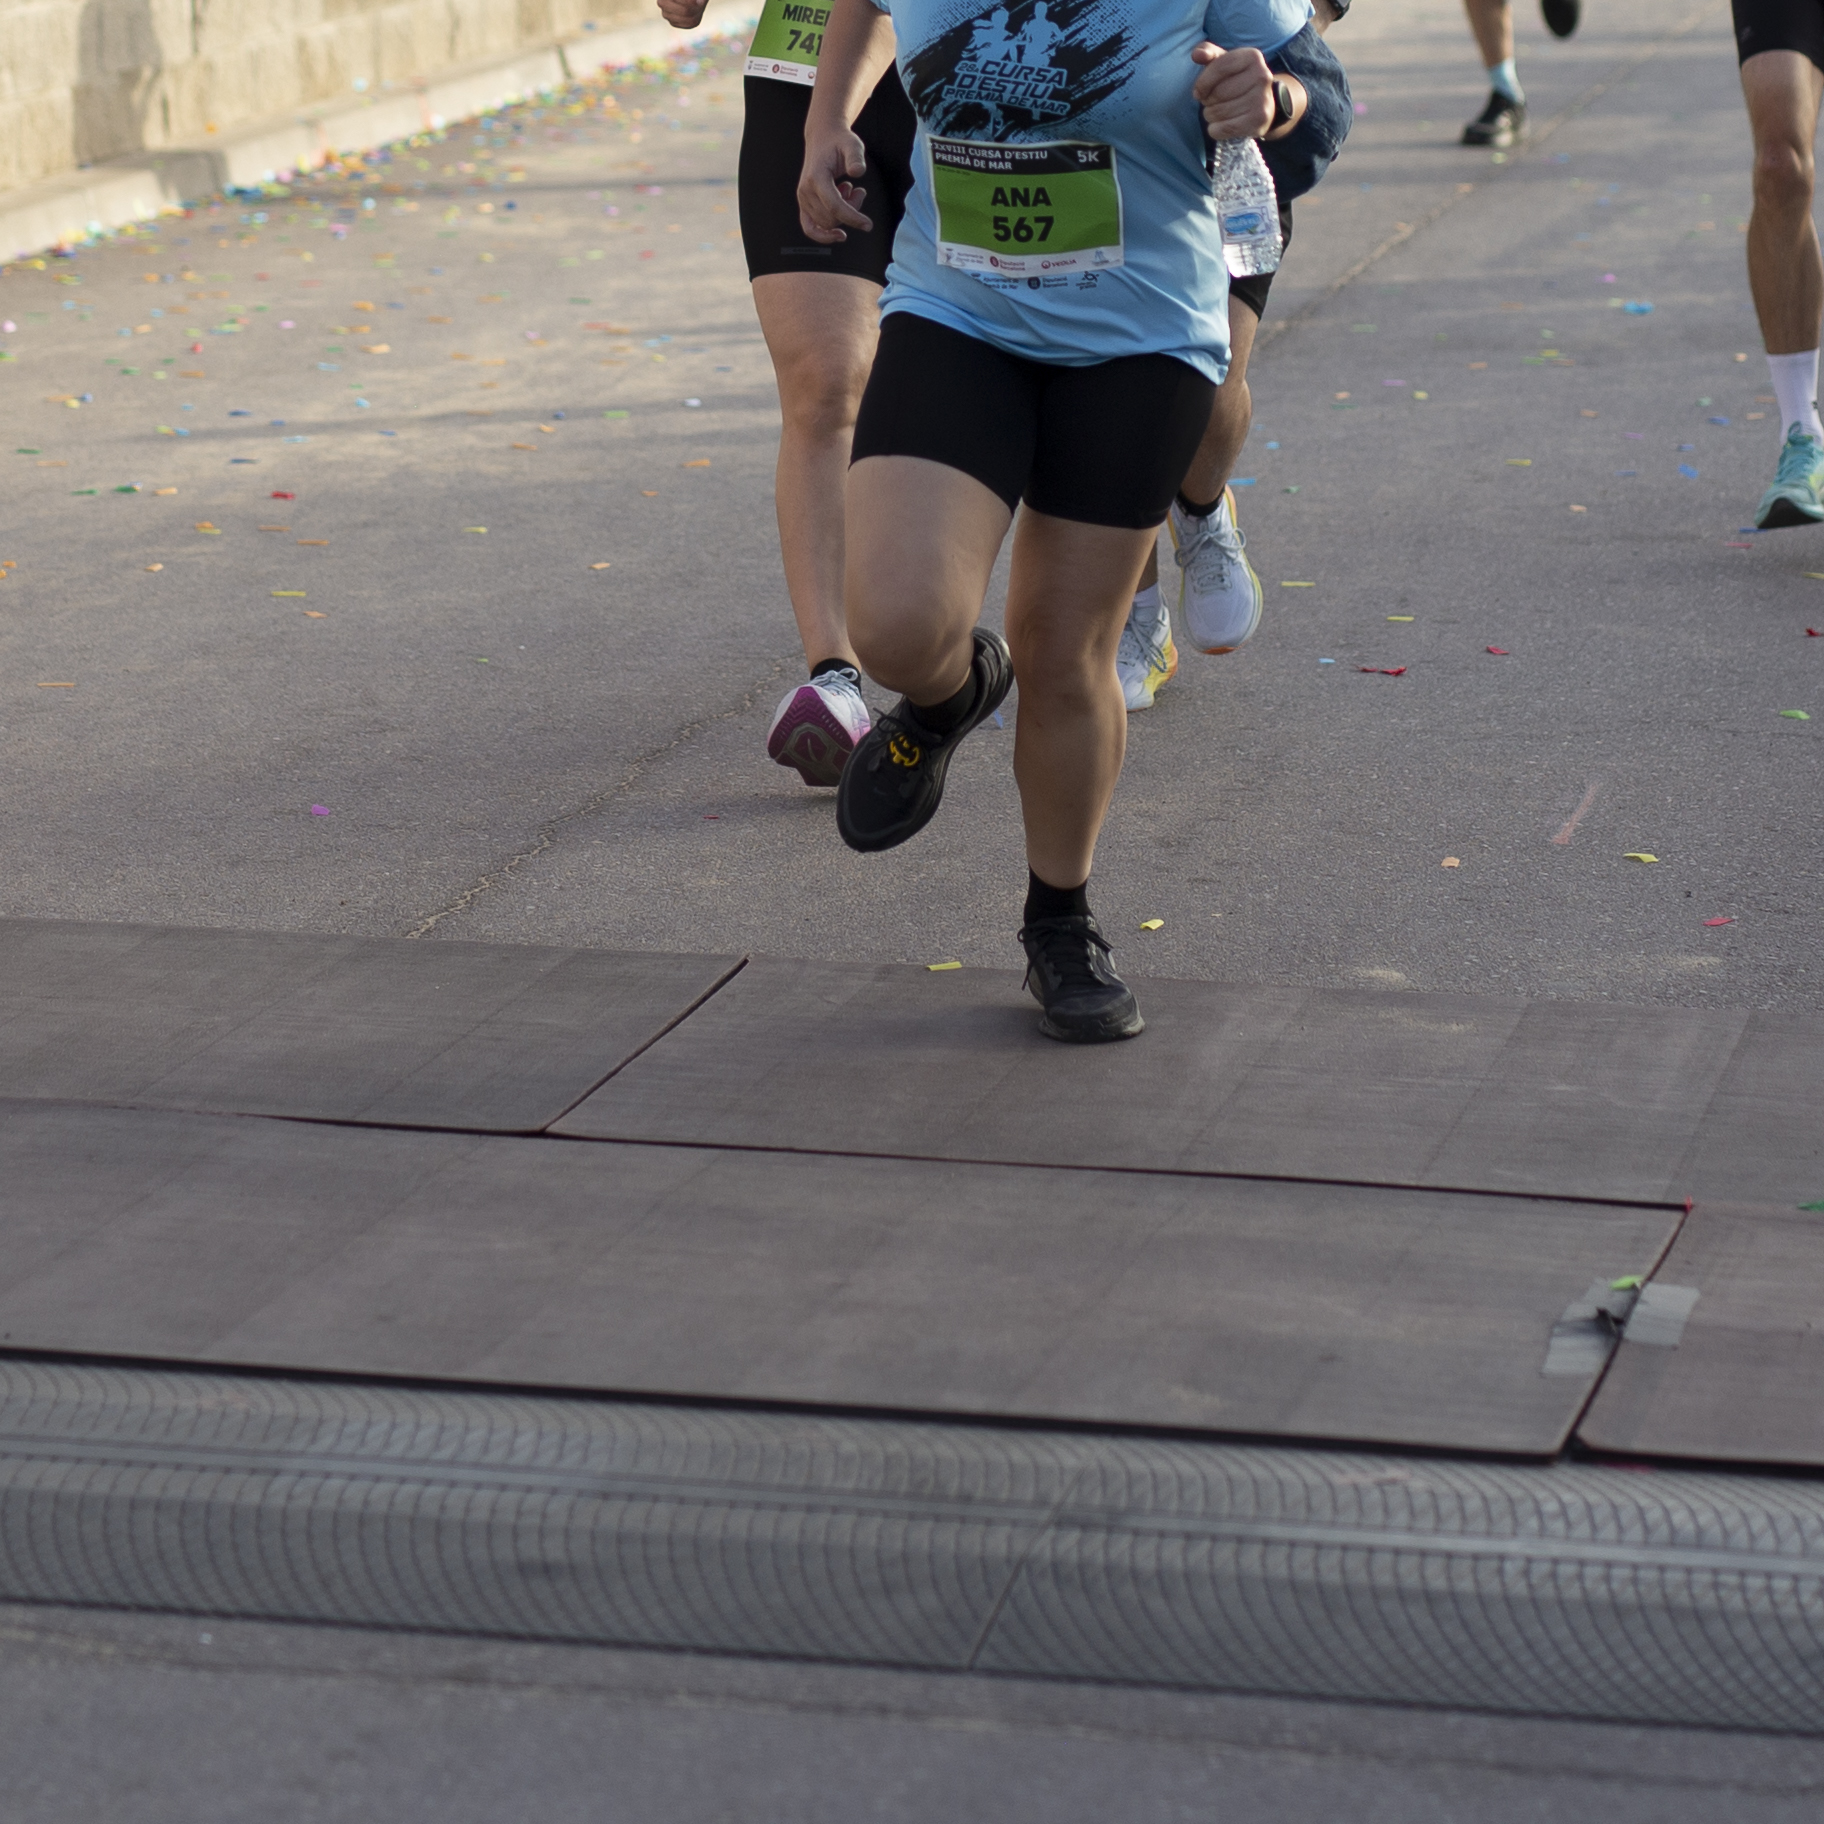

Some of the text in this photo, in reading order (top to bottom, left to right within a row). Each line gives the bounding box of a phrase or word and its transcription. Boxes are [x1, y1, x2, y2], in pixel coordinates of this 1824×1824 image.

[980, 60, 1066, 87] CURSA
[956, 75, 1051, 100] D'ESTIU
[1006, 95, 1029, 107] DE
[1029, 98, 1069, 114] MAR
[935, 152, 1013, 170] PREMIÀ DE MAR
[968, 148, 1002, 160] CURSA
[1004, 150, 1048, 160] D'ESTIU
[1077, 149, 1100, 163] 5K
[990, 186, 1053, 207] ANA
[993, 215, 1054, 243] 567
